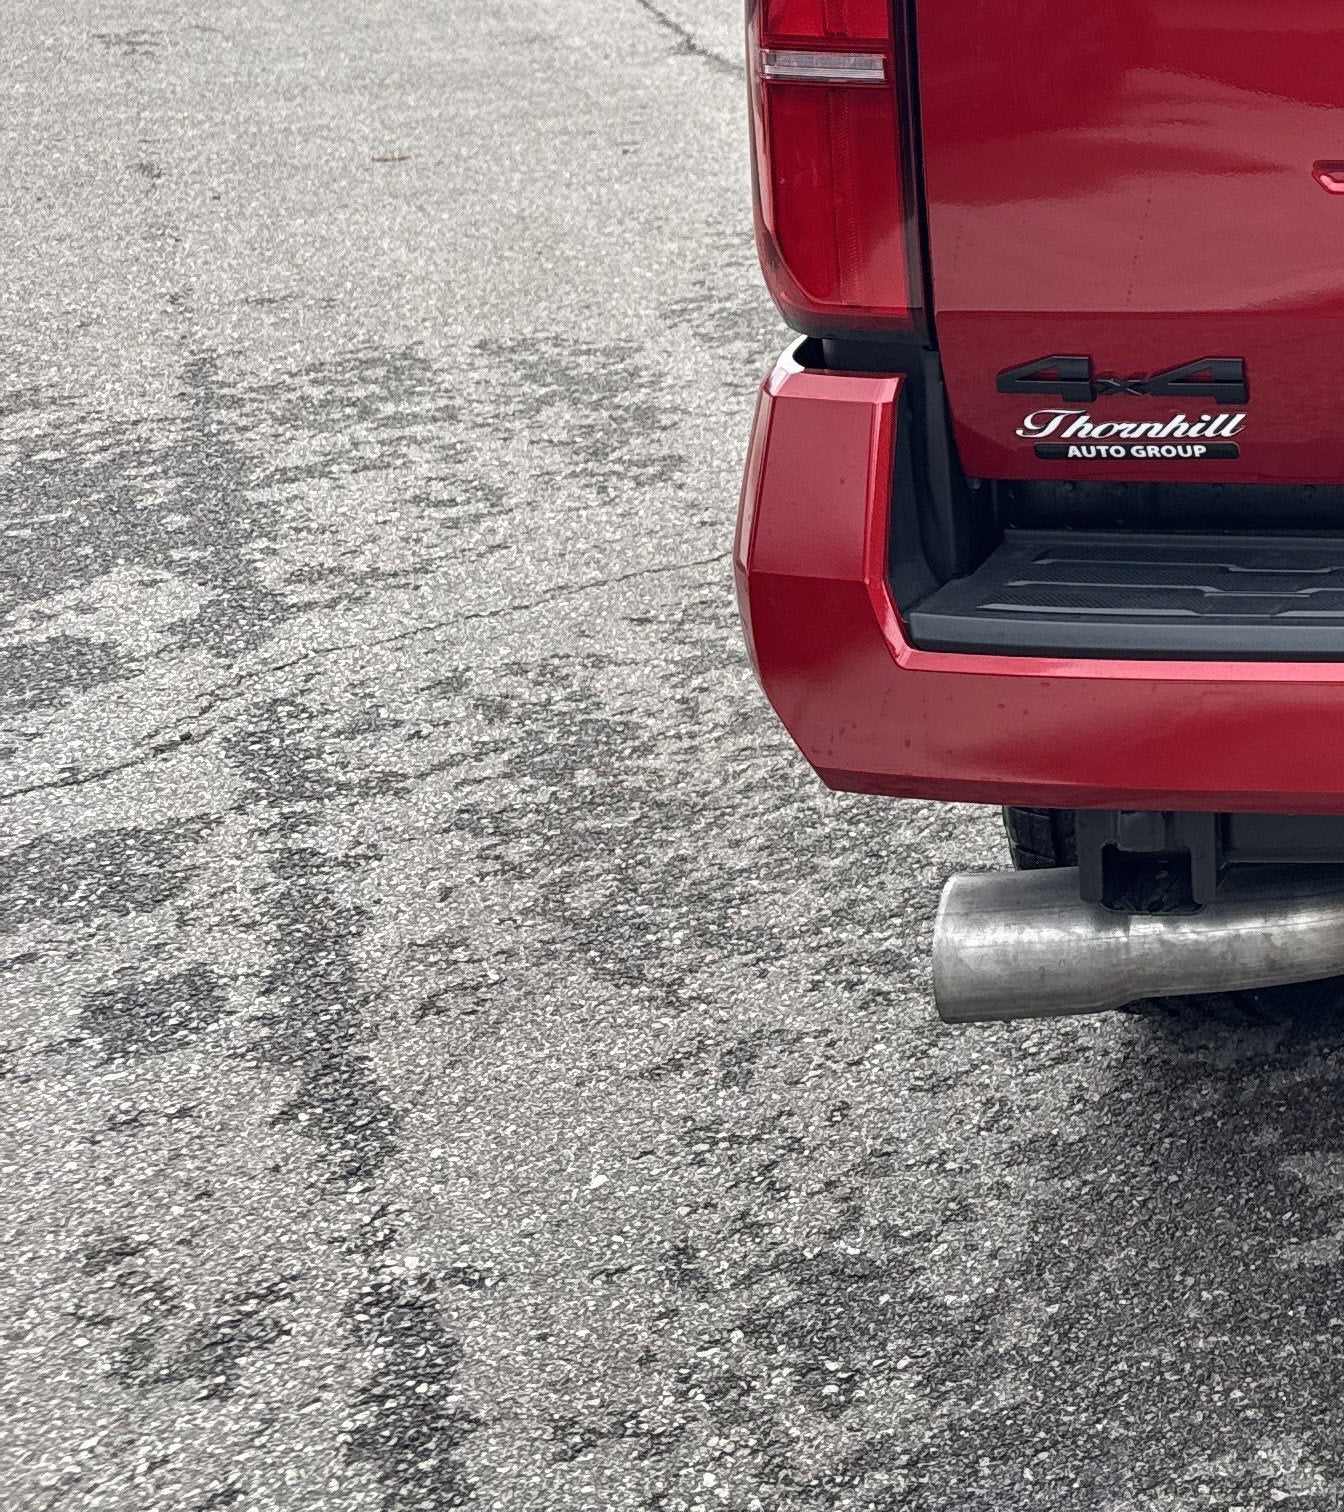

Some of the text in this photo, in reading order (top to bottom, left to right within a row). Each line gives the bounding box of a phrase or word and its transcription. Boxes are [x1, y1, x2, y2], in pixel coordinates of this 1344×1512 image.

[1015, 408, 1247, 439] Thornhill
[1067, 445, 1208, 459] AUTO GROUP
